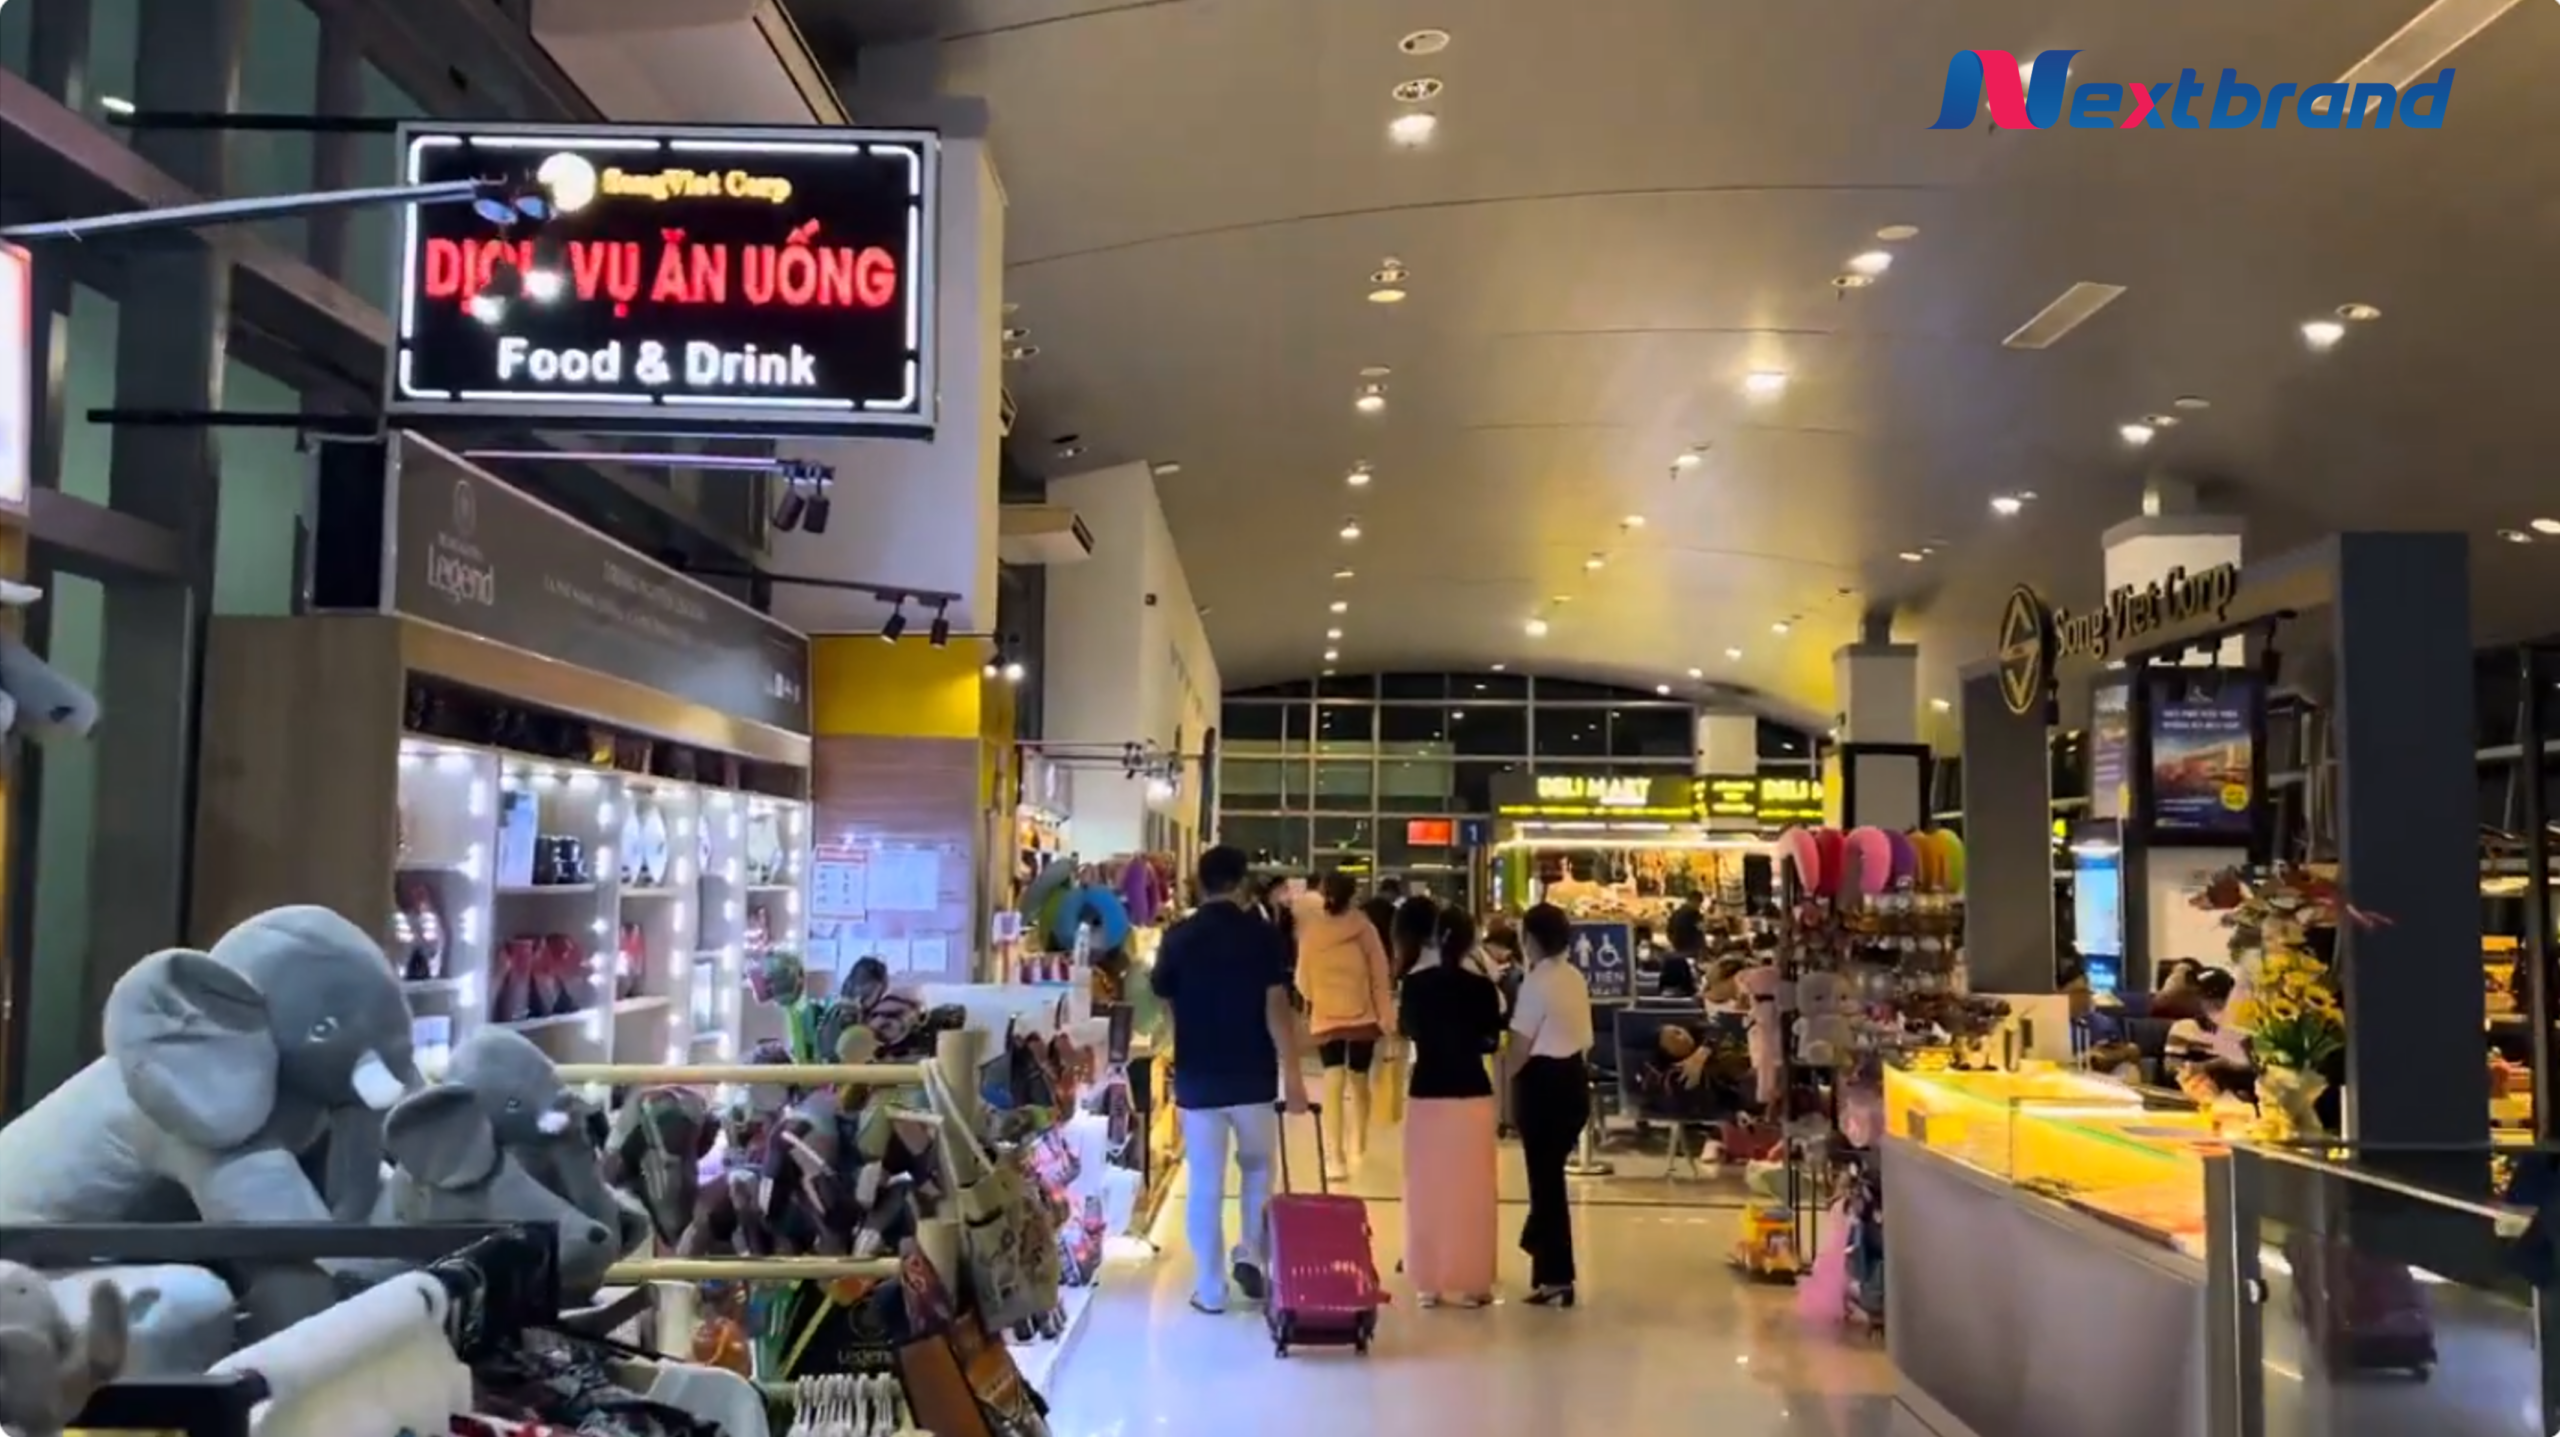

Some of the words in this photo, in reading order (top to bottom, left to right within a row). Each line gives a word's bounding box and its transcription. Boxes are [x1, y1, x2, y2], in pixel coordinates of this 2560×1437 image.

[725, 170, 792, 203] Corp
[569, 240, 641, 318] VỤ
[652, 227, 727, 303] ĂN
[743, 218, 896, 307] UỐNG
[497, 337, 621, 383] Food
[635, 340, 671, 385] &
[686, 341, 817, 387] Drink
[427, 543, 496, 606] Legend
[2053, 605, 2110, 661] Song
[2109, 583, 2162, 641] Viet
[2162, 562, 2237, 622] Corp
